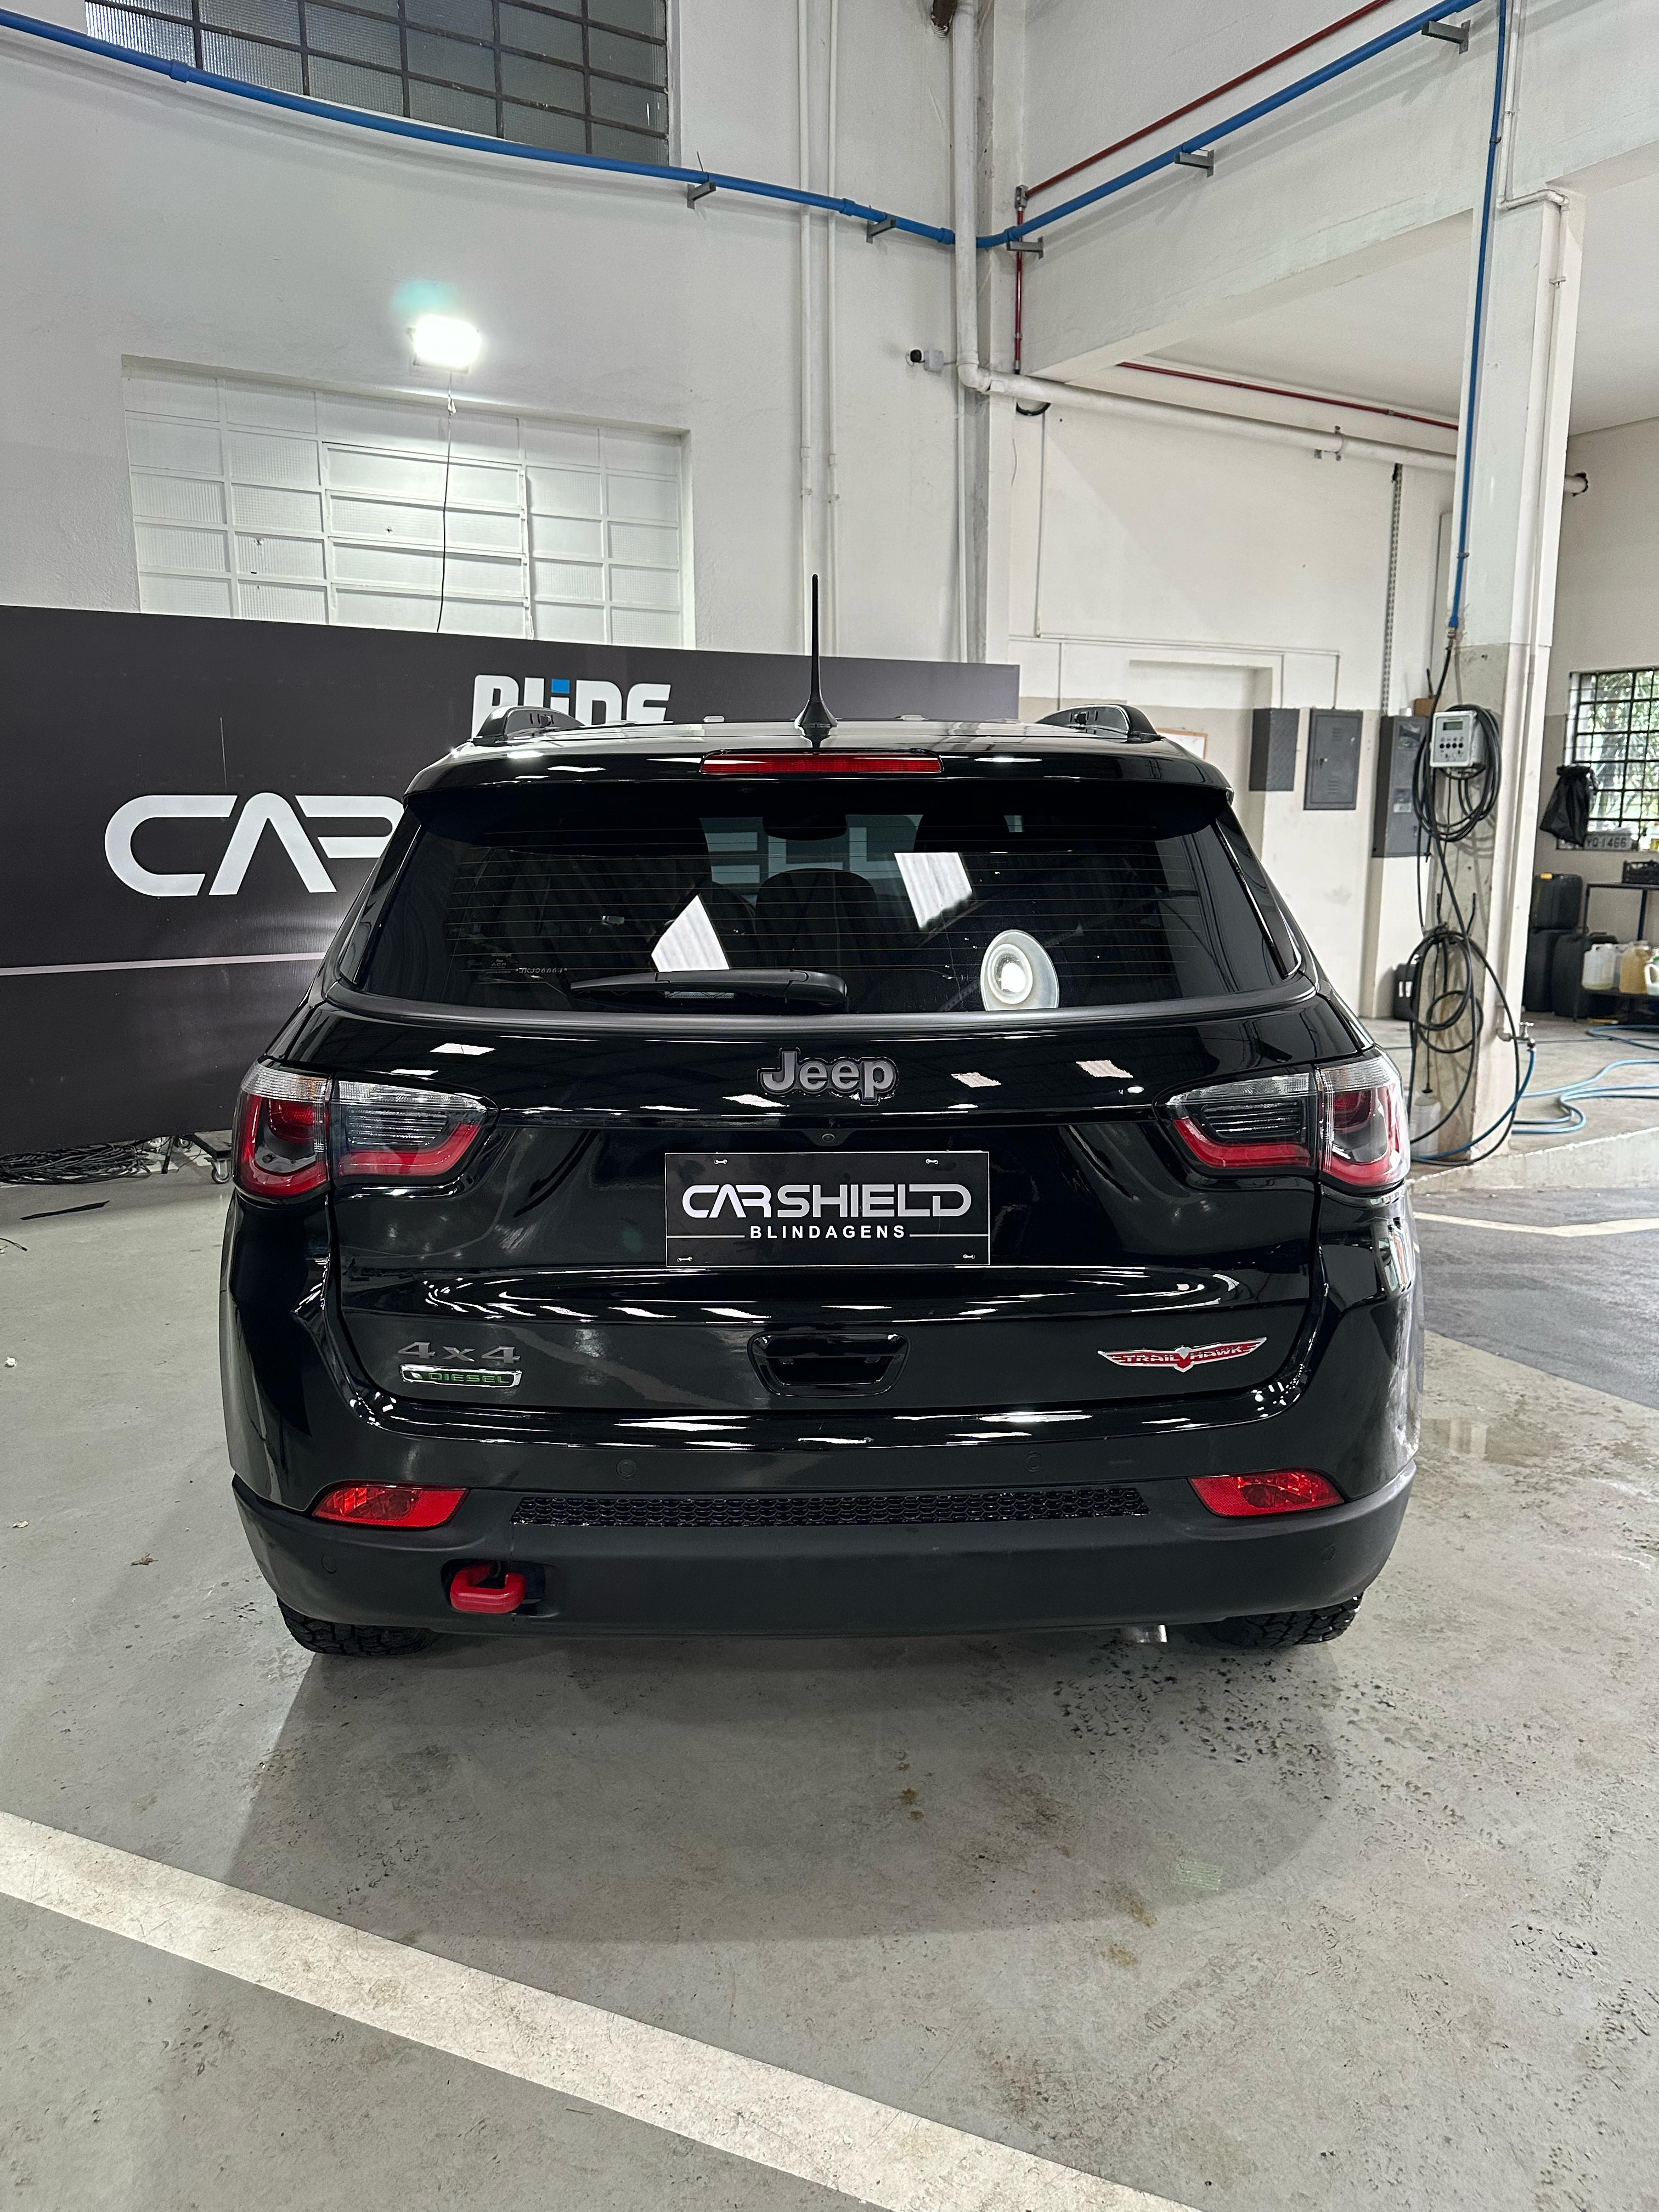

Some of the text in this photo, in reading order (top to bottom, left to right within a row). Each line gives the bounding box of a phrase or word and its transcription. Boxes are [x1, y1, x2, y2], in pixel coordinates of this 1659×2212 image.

[760, 1049, 896, 1103] Jeep
[682, 1184, 972, 1218] CARSHIELD
[750, 1224, 905, 1239] BLINDAGENS
[428, 1373, 510, 1383] DIESEL
